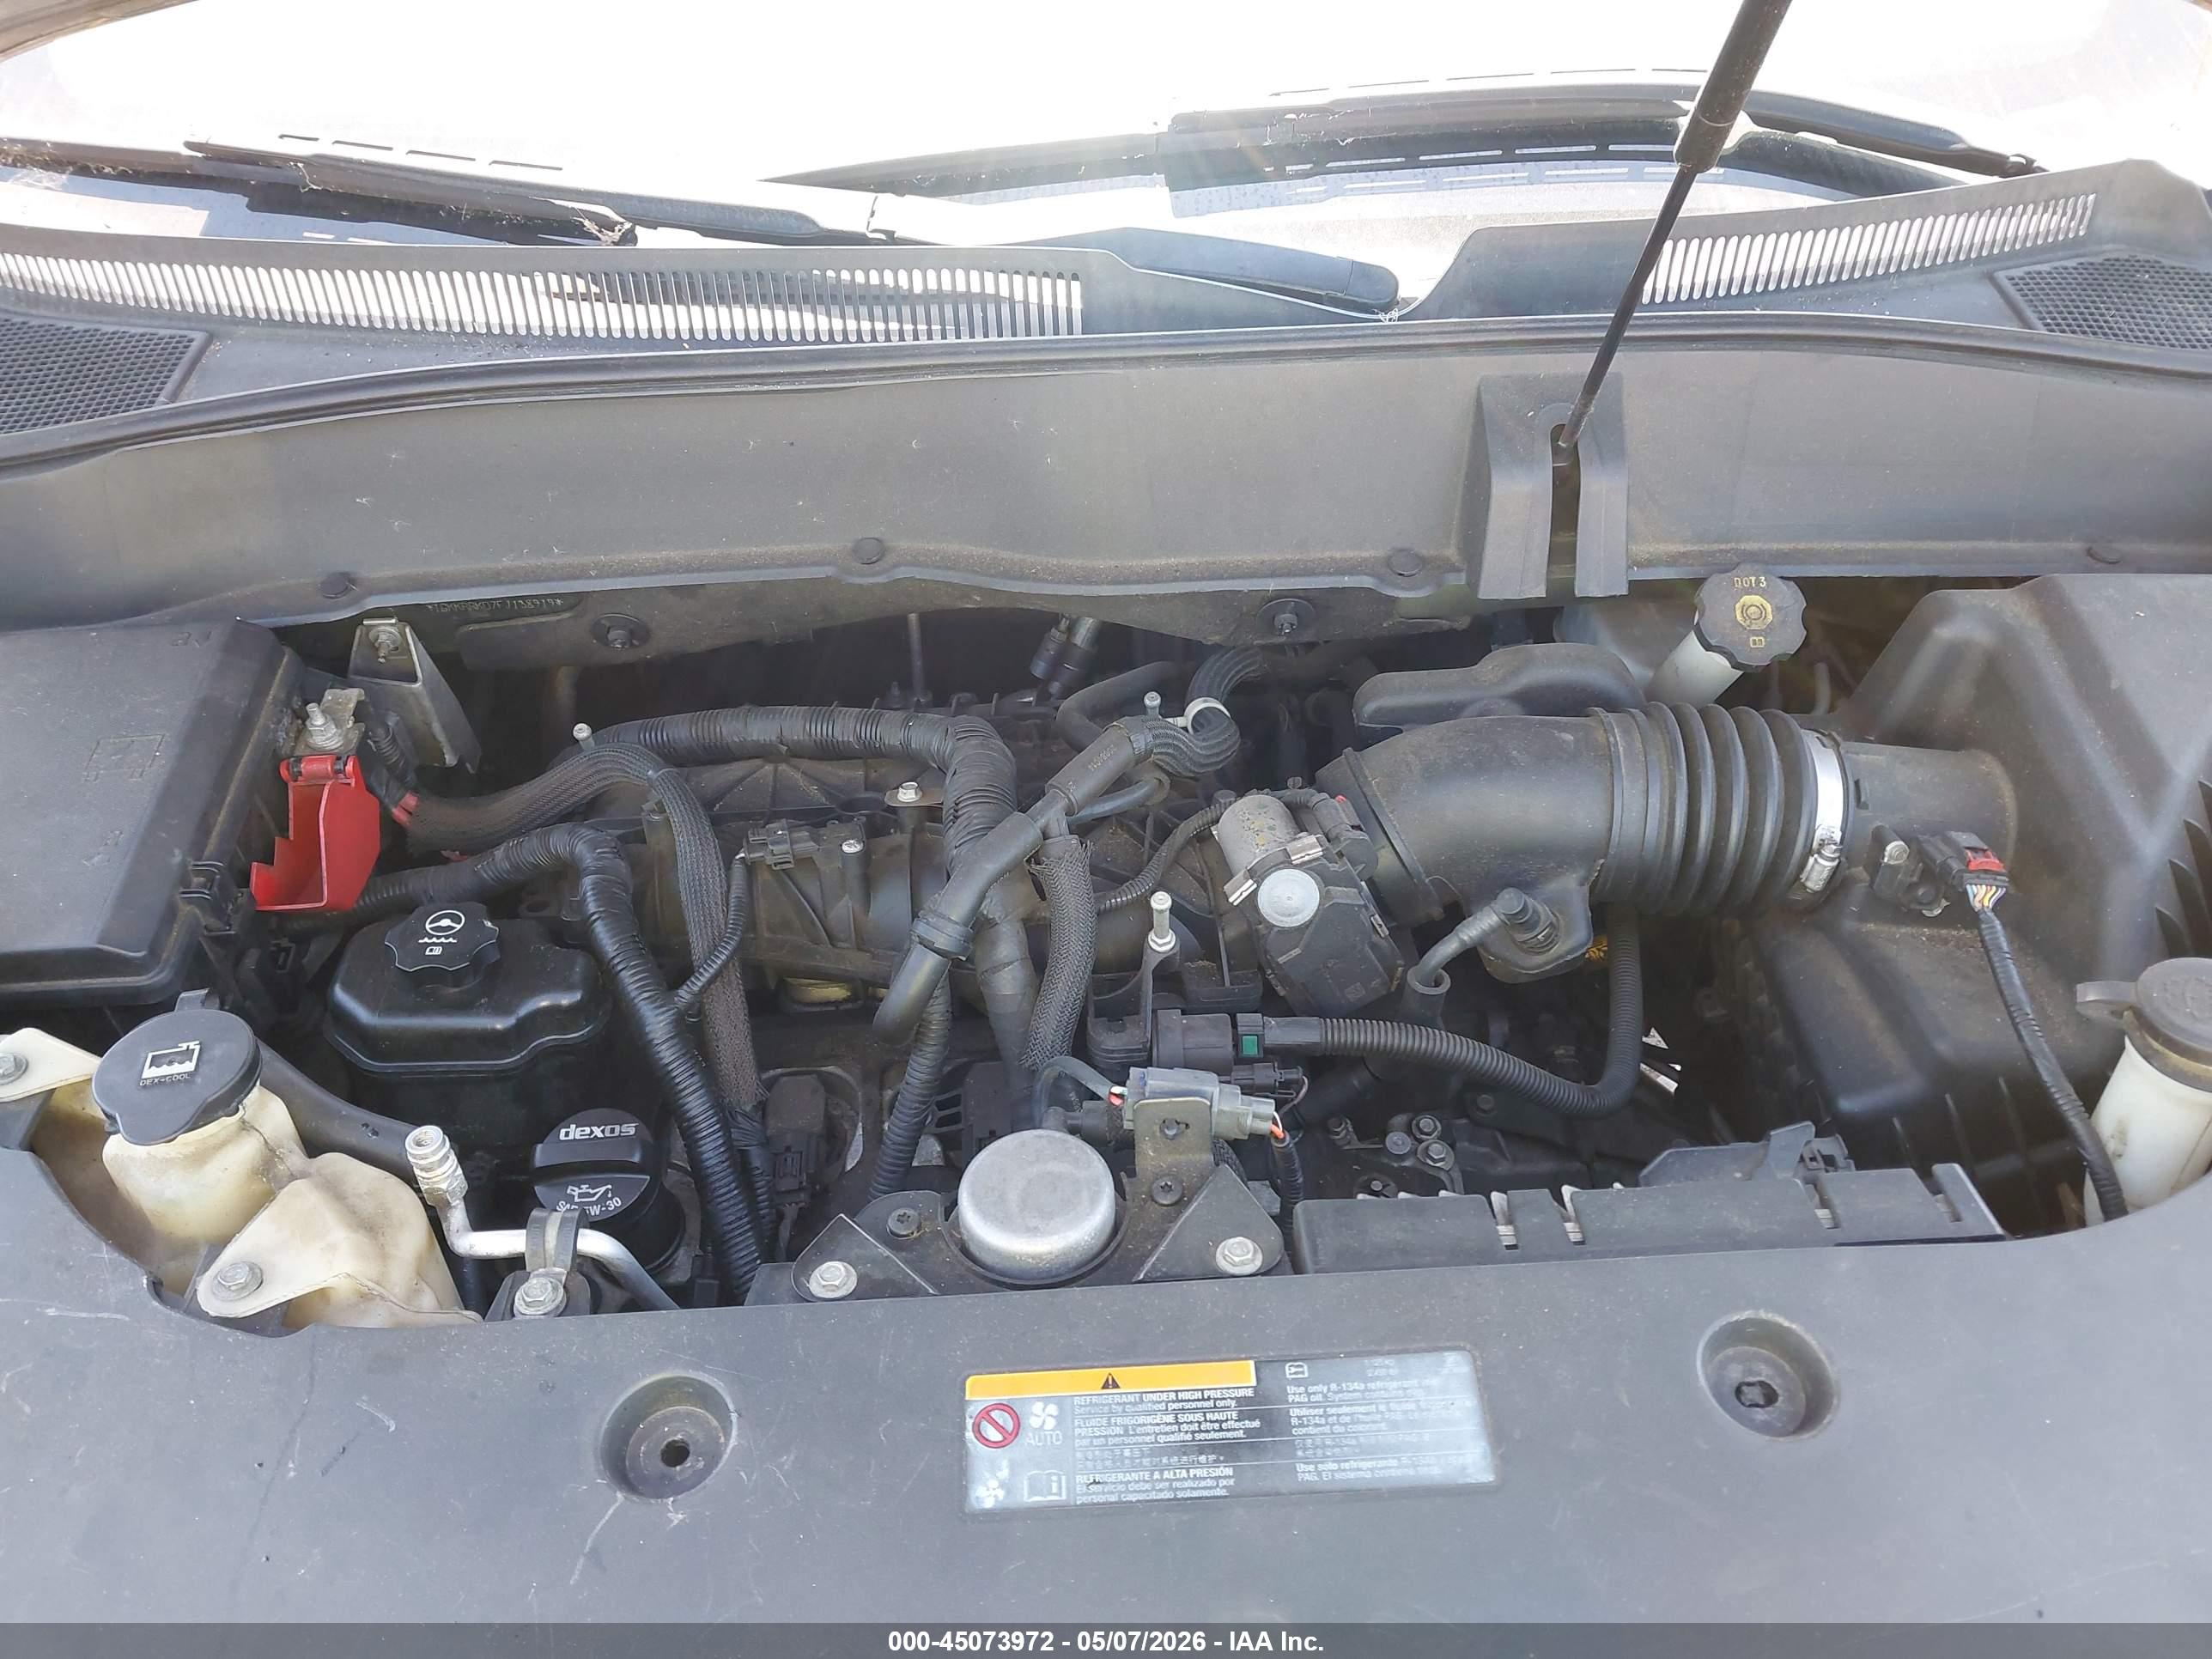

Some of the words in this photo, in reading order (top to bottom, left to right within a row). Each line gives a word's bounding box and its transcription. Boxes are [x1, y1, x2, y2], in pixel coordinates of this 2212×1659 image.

[1734, 576, 1756, 588] DOT
[1759, 576, 1767, 587] 3
[559, 1122, 640, 1140] dexos
[1286, 1385, 1305, 1394] Use
[1307, 1383, 1328, 1394] only
[1329, 1382, 1365, 1391] R-134a
[1073, 1394, 1141, 1406] REFRIGERANT
[1142, 1392, 1176, 1401] UNDER
[1177, 1390, 1202, 1401] HIGH
[1203, 1388, 1255, 1399] PRESSURE
[1168, 1399, 1214, 1411] personnel
[1215, 1398, 1237, 1408] only.
[1288, 1394, 1308, 1403] PAG
[1074, 1417, 1109, 1427] FLUIDE
[1111, 1413, 1176, 1425] FRIGORIGÈNE
[1177, 1413, 1204, 1422] SOUS
[1206, 1411, 1239, 1421] HAUTE
[1128, 1423, 1178, 1434] L'entretien
[1180, 1422, 1200, 1432] doit
[1200, 1421, 1220, 1431] être
[1221, 1419, 1261, 1430] effectué
[1291, 1415, 1326, 1425] R-134a
[1327, 1415, 1338, 1425] et
[1024, 1431, 1063, 1447] AUTO
[1108, 1435, 1155, 1446] personnel
[1157, 1432, 1193, 1443] qualifié
[1194, 1429, 1247, 1441] seulement.
[1295, 1462, 1315, 1472] Use
[1316, 1462, 1339, 1471] solo
[1076, 1471, 1152, 1485] REFRIGERANTE
[1153, 1470, 1161, 1480] A
[1163, 1469, 1188, 1479] ALTA
[1188, 1466, 1234, 1478] PRESIÓN
[1172, 1478, 1217, 1489] realizado
[1218, 1478, 1236, 1487] por
[1076, 1493, 1119, 1505] personal
[1176, 1487, 1231, 1498] solamente.
